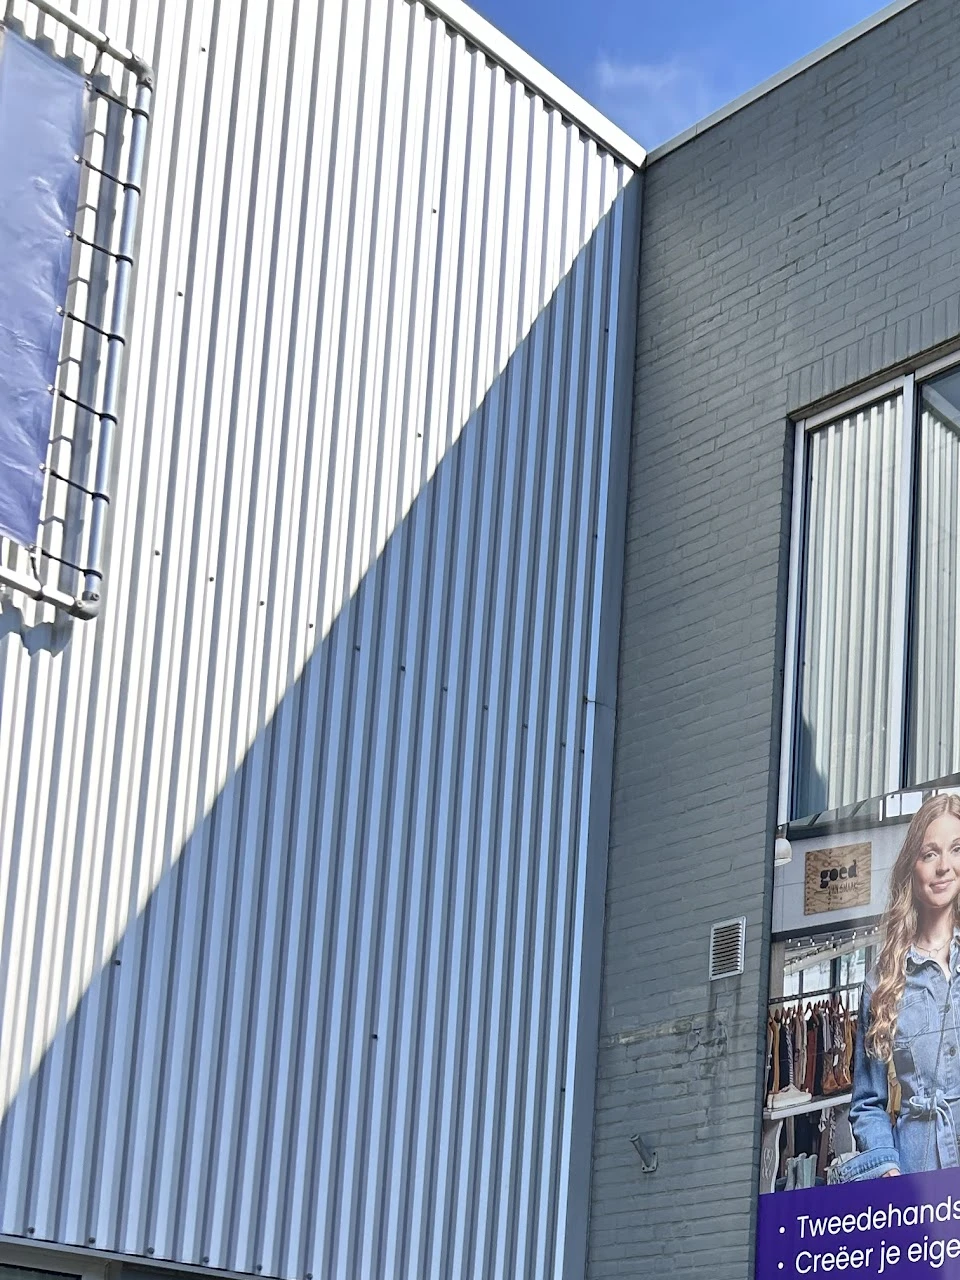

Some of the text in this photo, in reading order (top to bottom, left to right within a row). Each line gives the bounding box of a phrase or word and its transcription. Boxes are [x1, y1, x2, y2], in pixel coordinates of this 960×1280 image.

[820, 859, 858, 889] goed
[795, 1244, 874, 1275] Creëer
[878, 1239, 900, 1275] je
